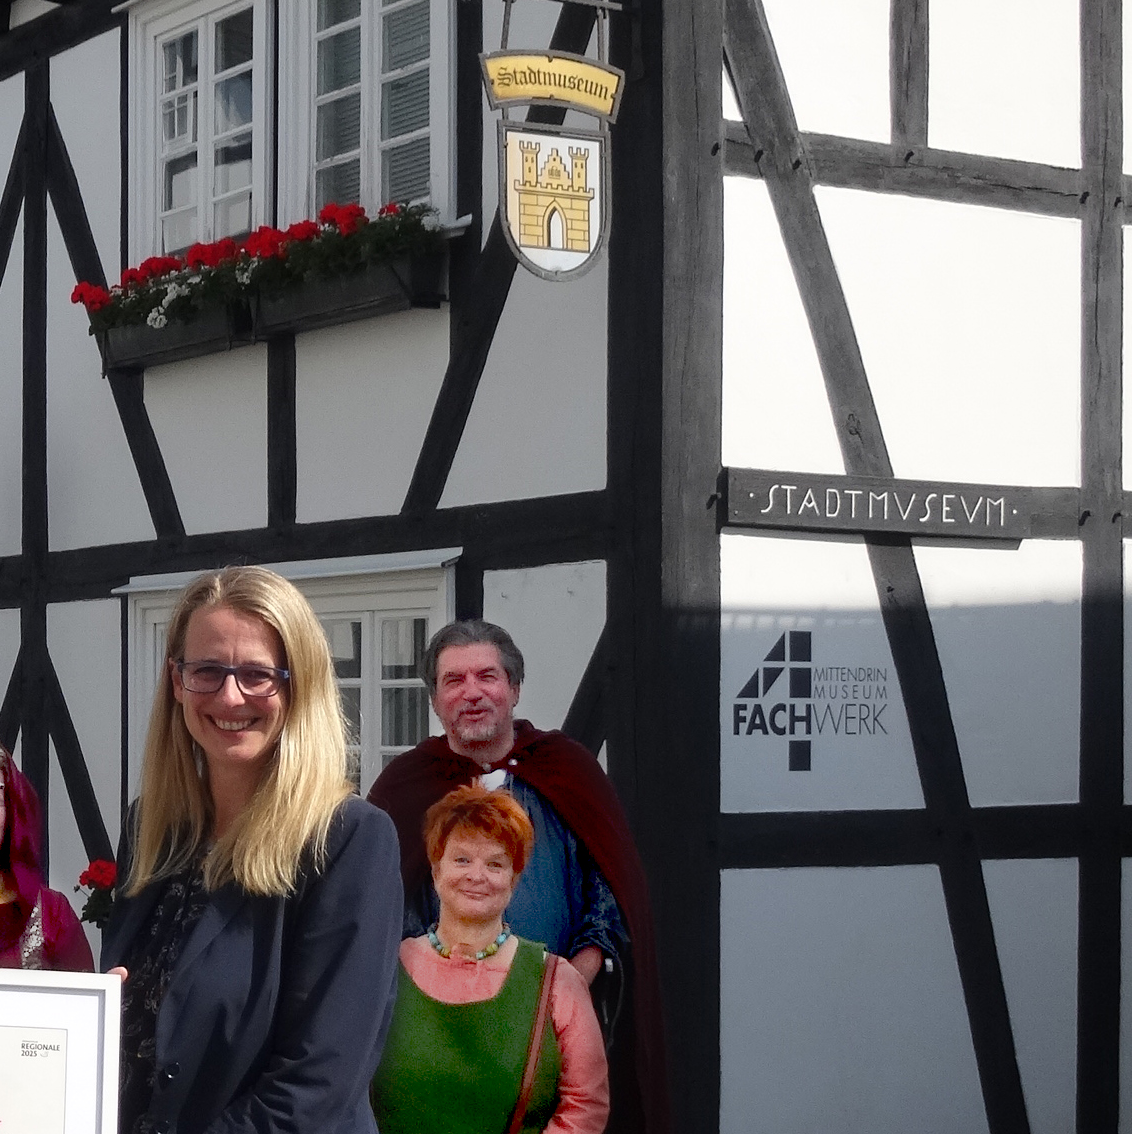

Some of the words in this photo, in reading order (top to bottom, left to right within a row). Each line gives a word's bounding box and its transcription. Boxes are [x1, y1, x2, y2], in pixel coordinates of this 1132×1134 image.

[497, 65, 609, 100] Stadtmuseum
[813, 667, 888, 682] MITTENDRIN
[813, 685, 888, 699] MUSEUM
[733, 703, 888, 735] FACHWERK
[21, 1043, 60, 1051] REGIONALE
